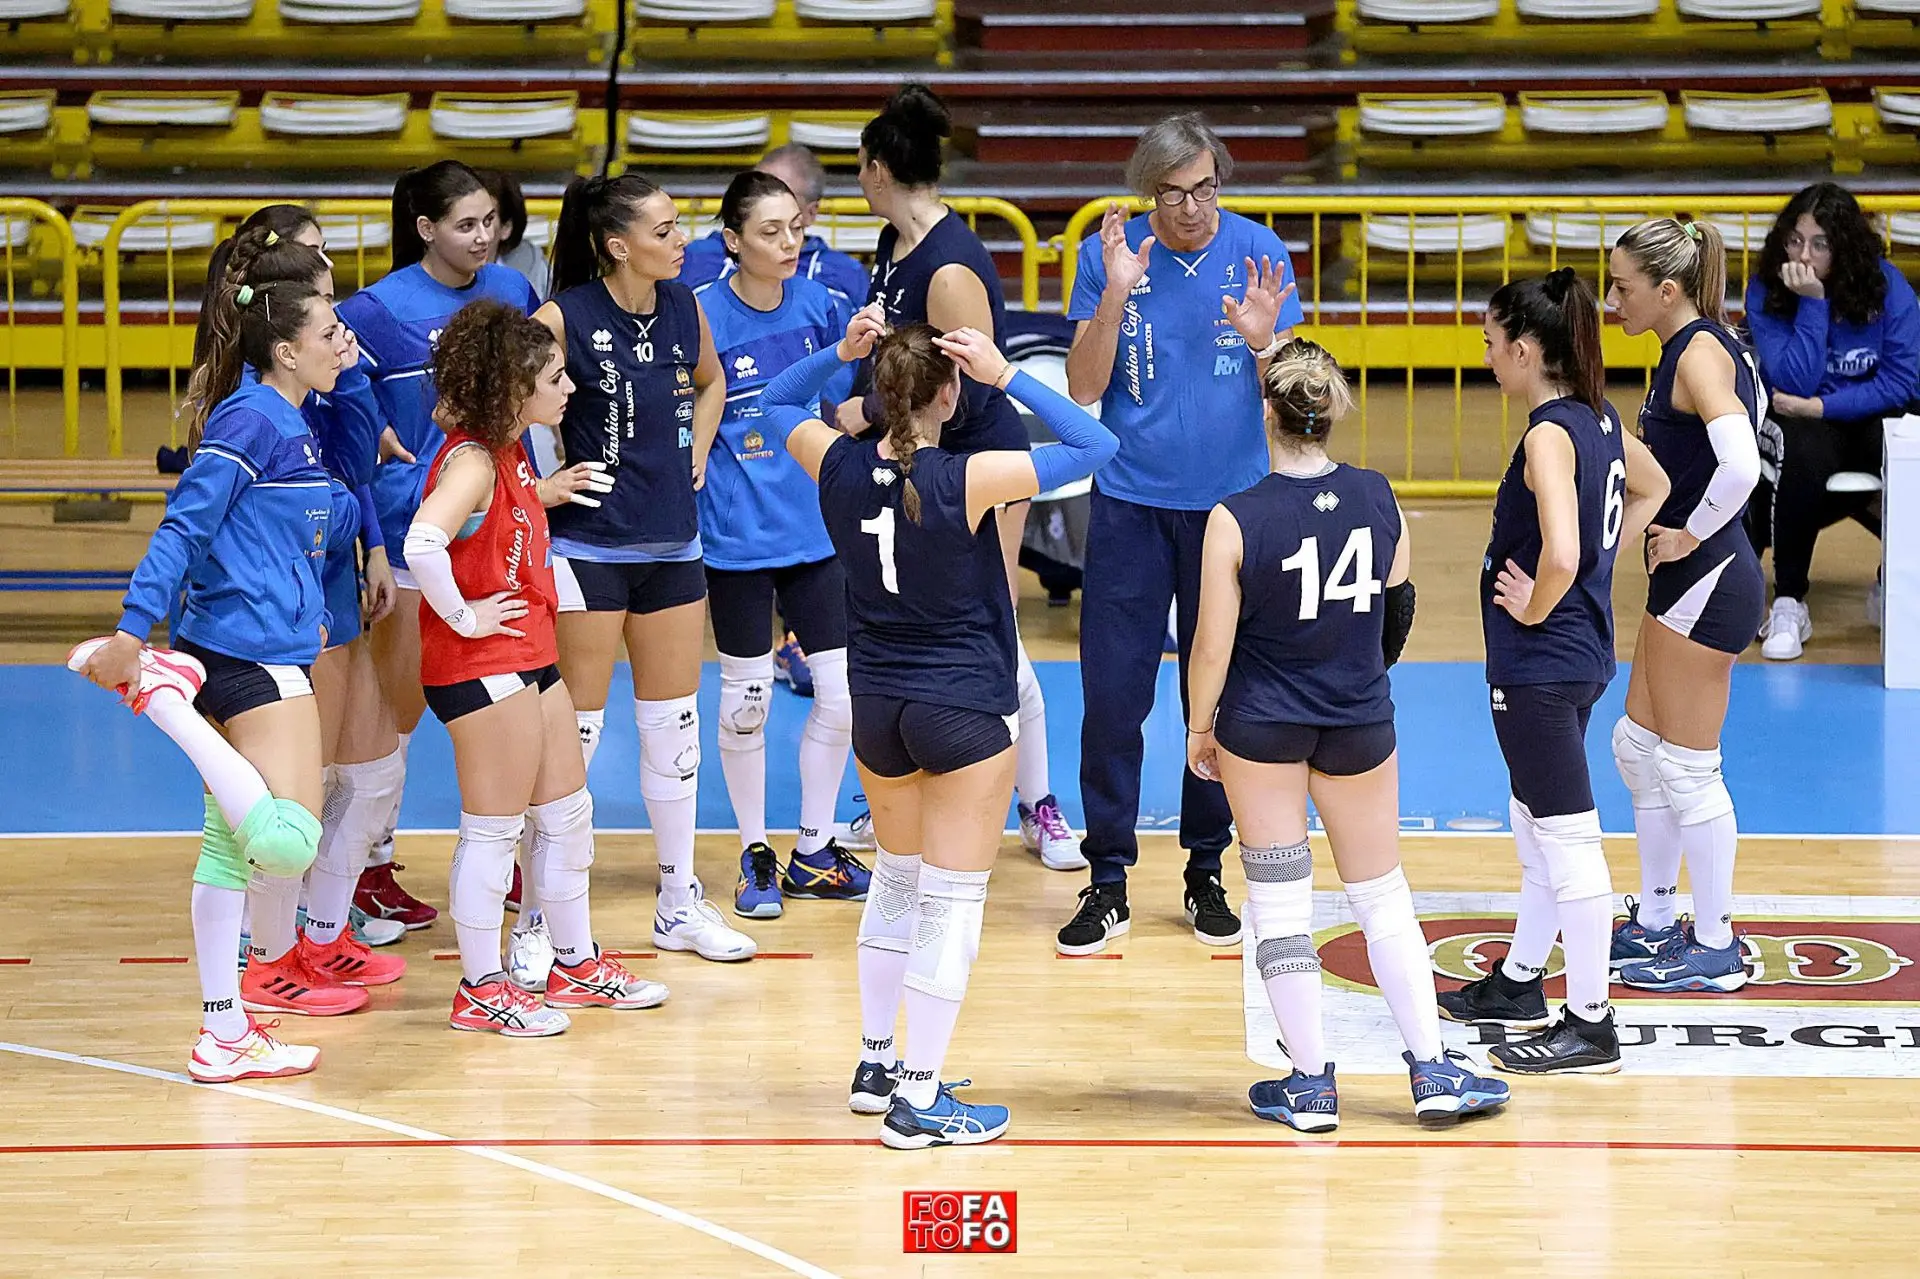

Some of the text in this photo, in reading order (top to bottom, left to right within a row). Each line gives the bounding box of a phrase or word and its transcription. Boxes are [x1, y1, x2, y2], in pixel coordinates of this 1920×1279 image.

[632, 341, 654, 363] 10
[736, 367, 759, 379] errea
[1125, 343, 1144, 406] Fashion
[602, 400, 620, 466] Fashion
[1602, 458, 1626, 550] 6
[861, 506, 900, 594] 1
[1281, 526, 1382, 620] 14
[744, 694, 762, 702] errea
[1306, 1099, 1336, 1111] MIZU
